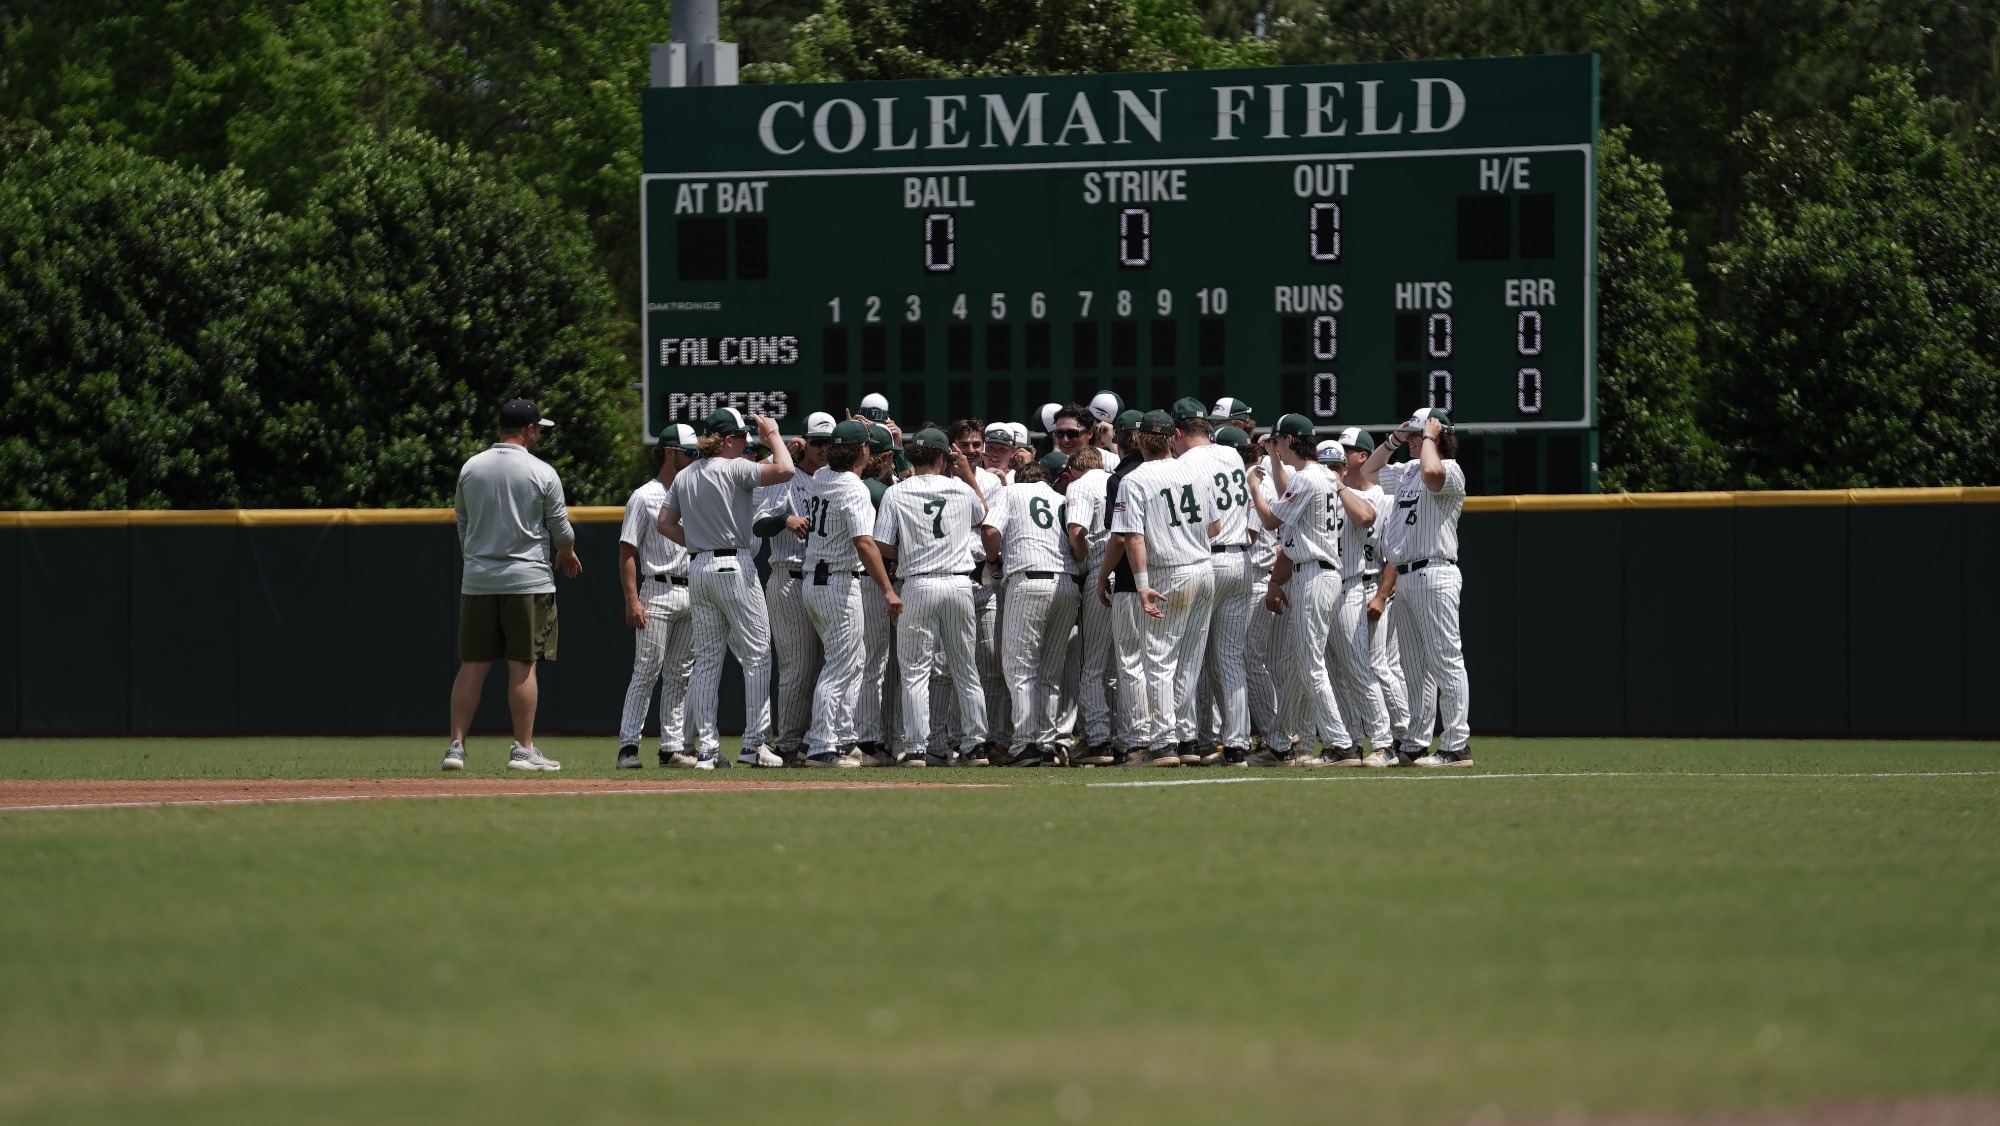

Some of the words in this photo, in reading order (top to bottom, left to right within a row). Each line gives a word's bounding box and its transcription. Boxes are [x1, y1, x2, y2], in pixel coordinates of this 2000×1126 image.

[758, 88, 1168, 155] COLEMAN
[1210, 77, 1467, 141] FIELD
[903, 175, 976, 208] BALL
[1083, 168, 1188, 205] STRIKE
[1292, 163, 1355, 198] OUT
[1478, 156, 1531, 193] H/E
[674, 182, 708, 214] AT
[716, 181, 769, 213] BAT
[924, 213, 955, 271] 0
[1119, 208, 1150, 267] 0
[1310, 202, 1341, 261] 0
[829, 296, 841, 322] 1
[866, 295, 881, 322] 2
[906, 294, 921, 321] 3
[952, 293, 968, 319] 4
[991, 292, 1006, 319] 5
[1031, 291, 1046, 319] 6
[1078, 290, 1093, 317] 7
[1117, 289, 1132, 316] 8
[1157, 288, 1172, 316] 9
[1196, 287, 1228, 315] 10
[1275, 284, 1344, 313] RUNS
[1395, 281, 1452, 310] HITS
[1505, 278, 1556, 307] ERR
[659, 336, 799, 367] FALCONS
[1313, 315, 1338, 360] 0
[1428, 313, 1452, 358] 0
[1517, 310, 1542, 355] 0
[668, 391, 788, 421] PACERS
[1313, 372, 1338, 418] 0
[1428, 369, 1452, 413] 0
[1517, 367, 1543, 413] 0
[1159, 483, 1203, 528] 14
[1212, 468, 1249, 511] 33
[923, 499, 947, 539] 7
